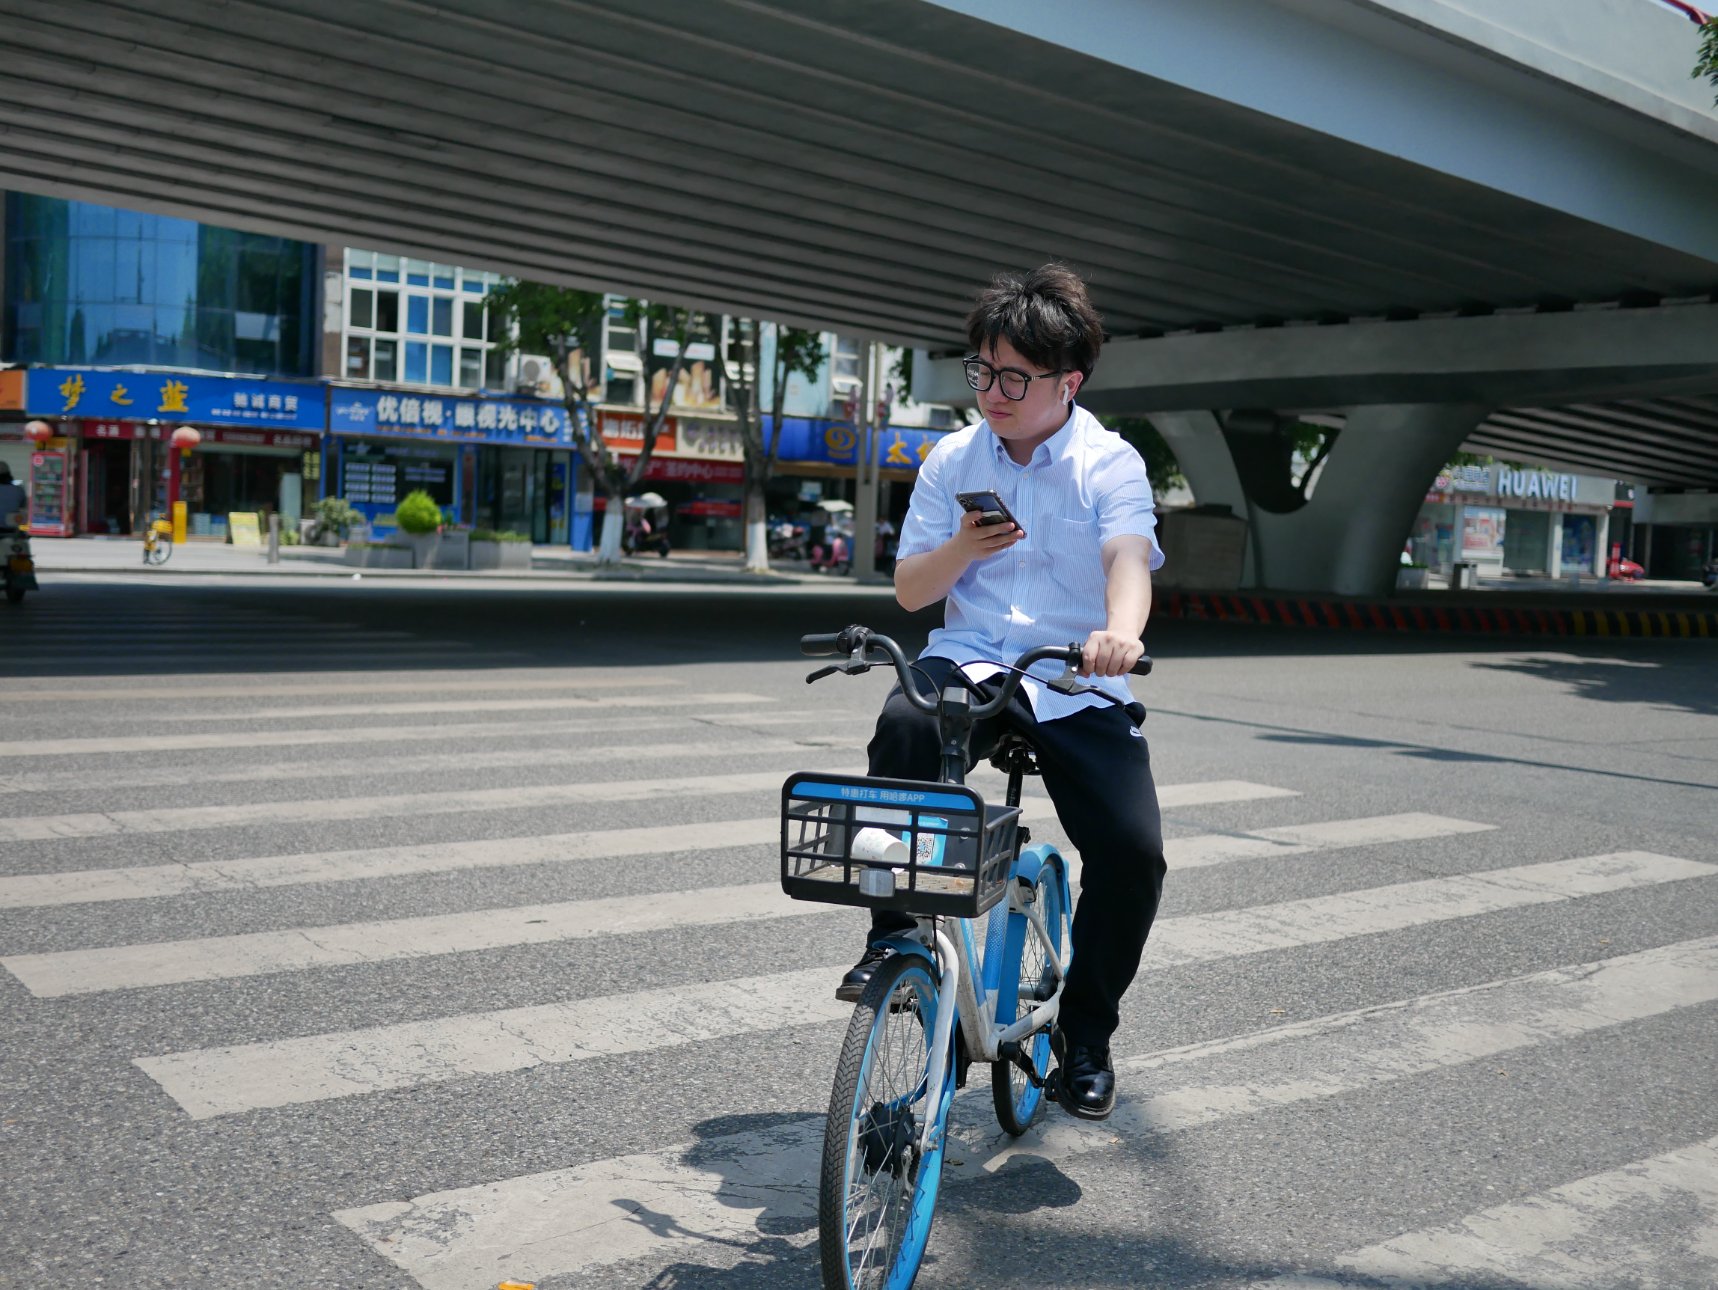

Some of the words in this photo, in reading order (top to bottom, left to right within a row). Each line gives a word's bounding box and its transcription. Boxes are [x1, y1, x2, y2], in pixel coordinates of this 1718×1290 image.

[58, 373, 190, 413] 梦之蓝
[1497, 468, 1578, 499] HUAWEI
